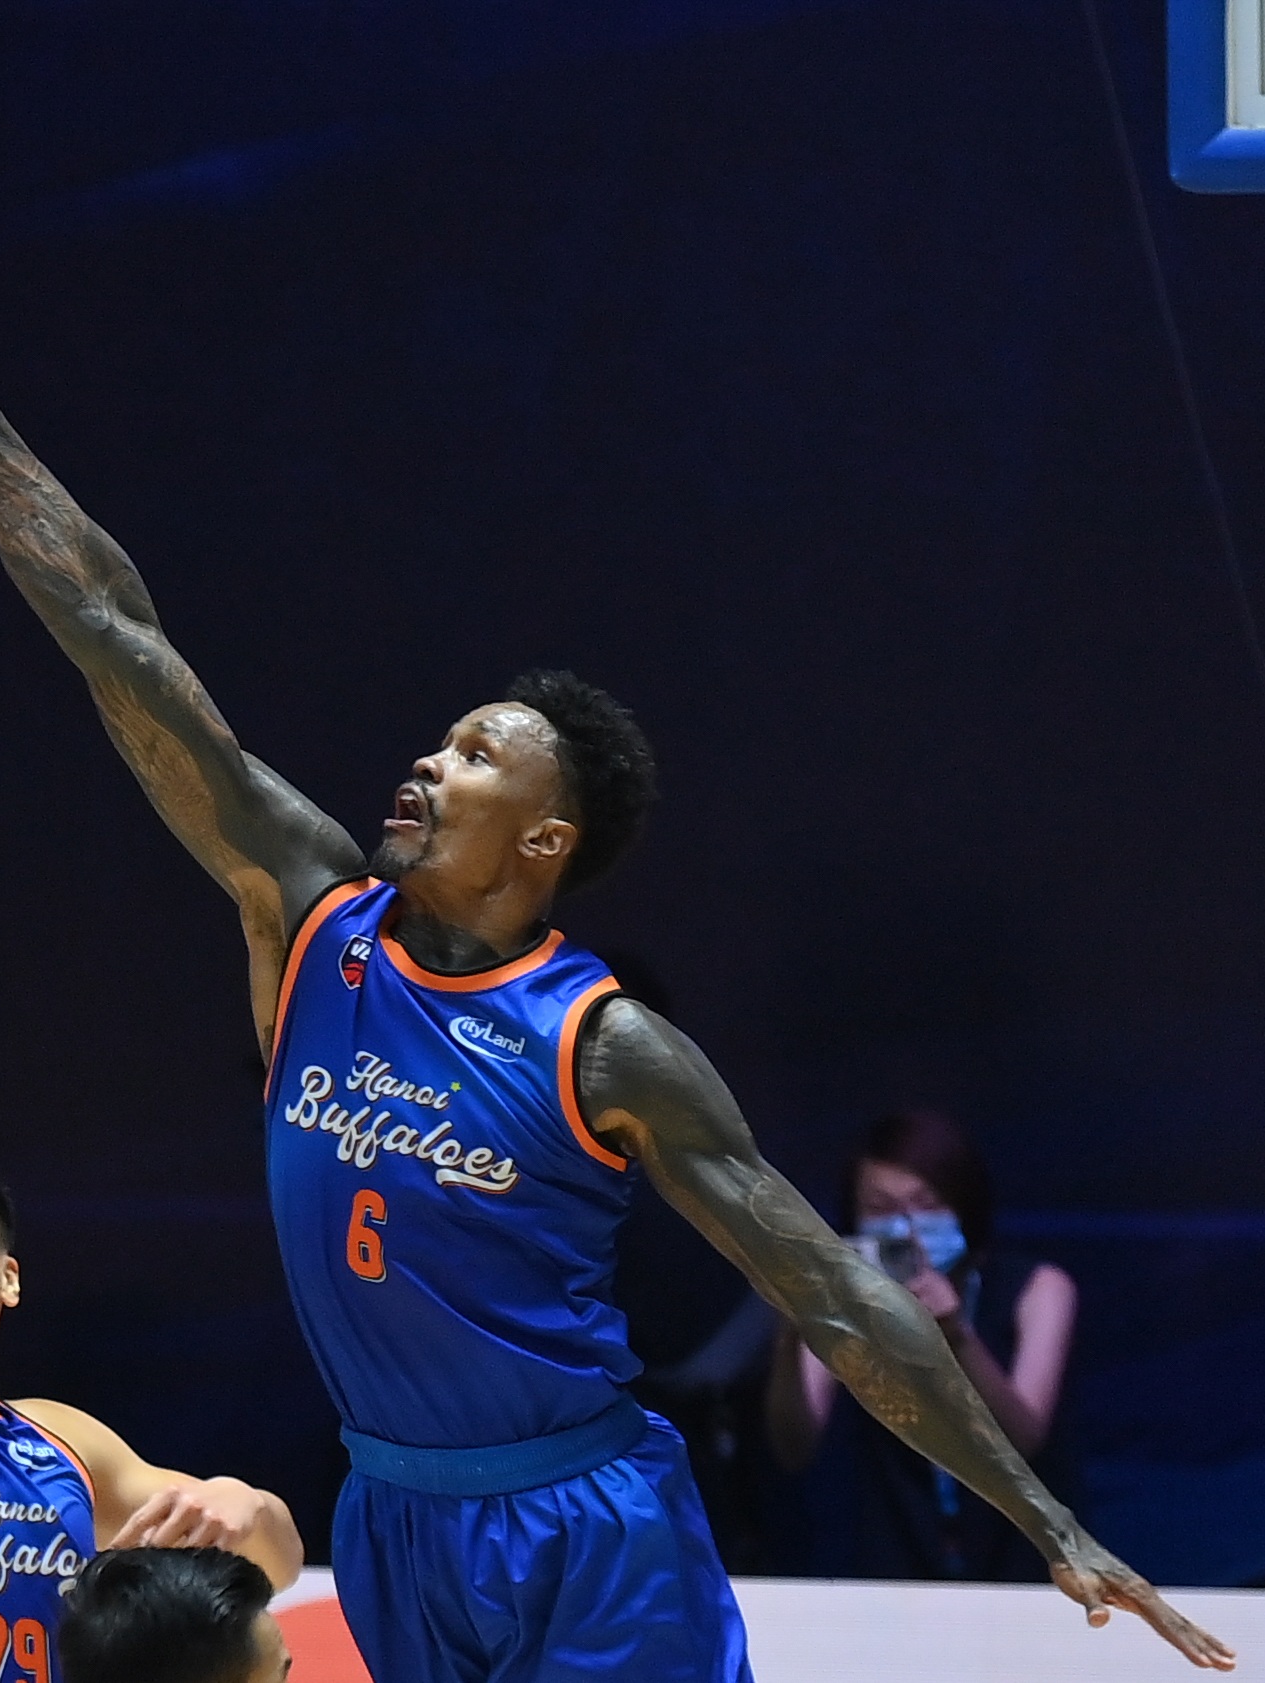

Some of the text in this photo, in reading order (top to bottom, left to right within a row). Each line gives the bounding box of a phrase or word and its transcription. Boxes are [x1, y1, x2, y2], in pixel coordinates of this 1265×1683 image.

[449, 1016, 525, 1062] CityLand
[345, 1050, 462, 1110] Hanoi
[285, 1065, 520, 1194] Buffaloes
[346, 1188, 387, 1282] 6
